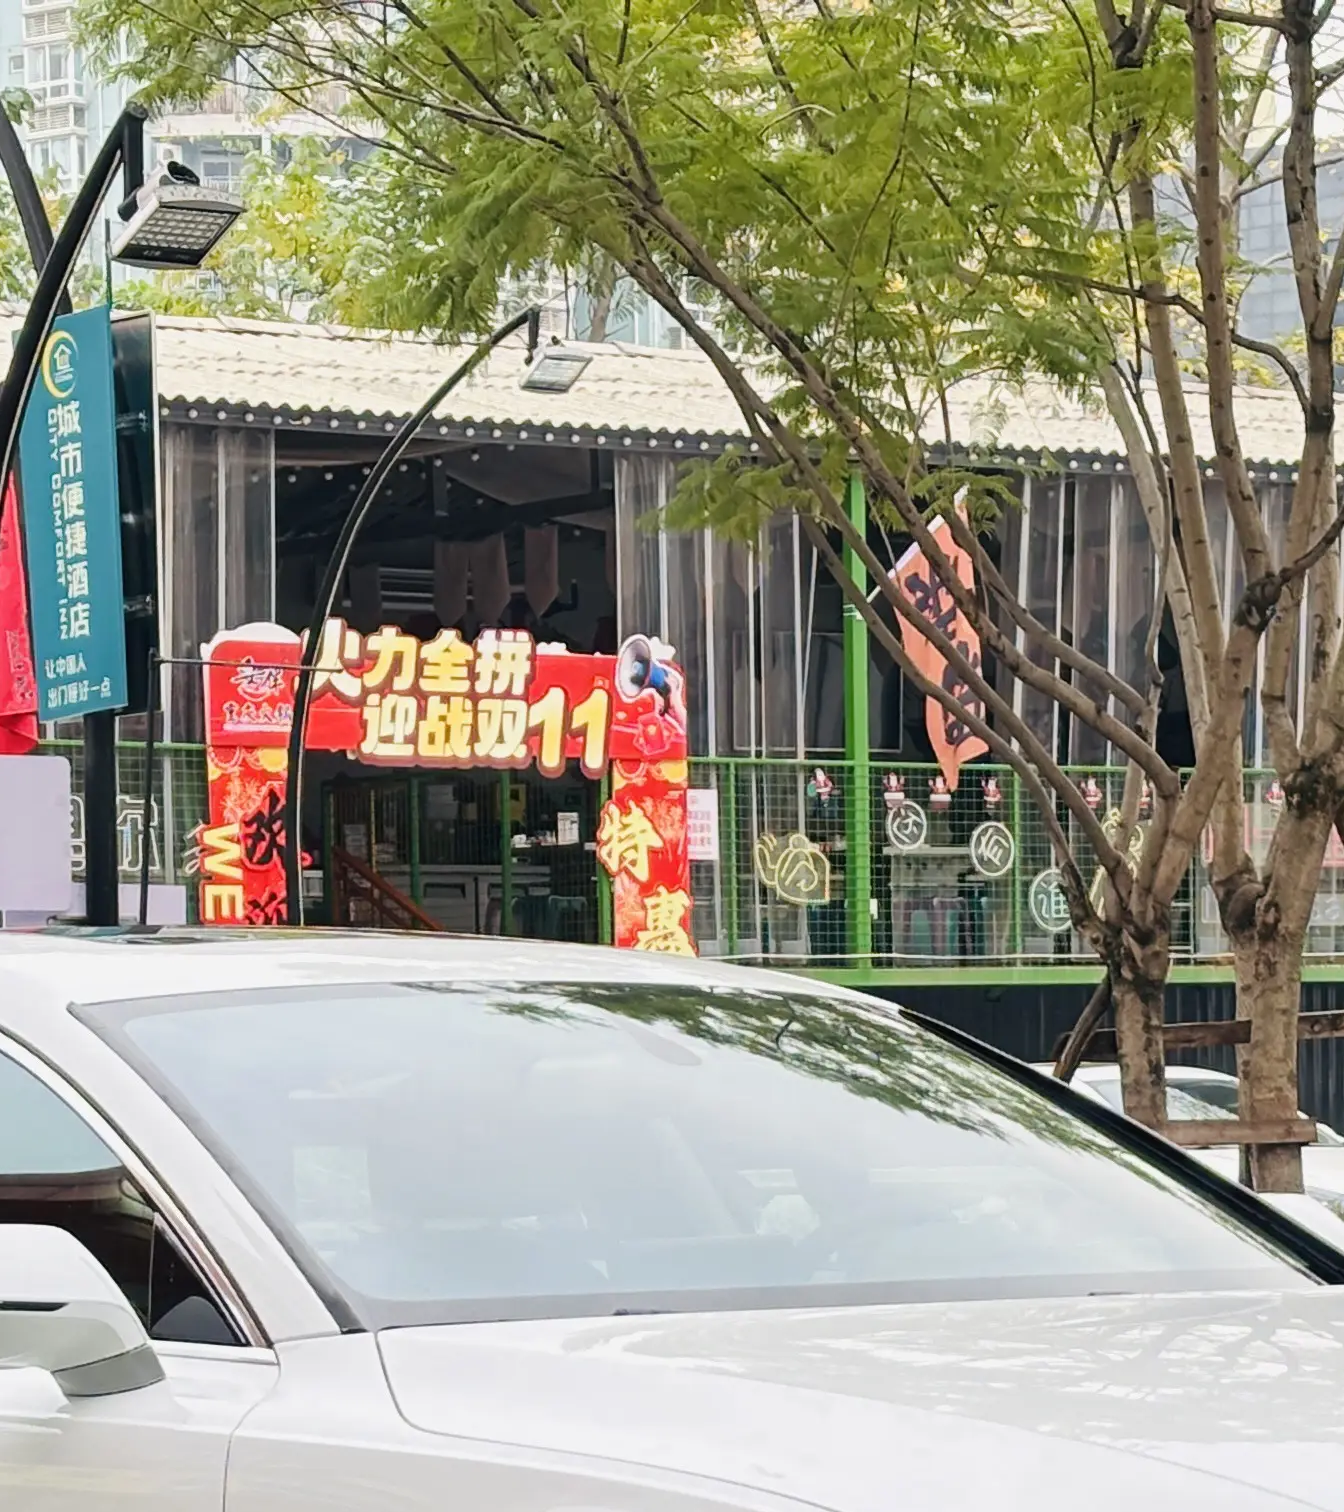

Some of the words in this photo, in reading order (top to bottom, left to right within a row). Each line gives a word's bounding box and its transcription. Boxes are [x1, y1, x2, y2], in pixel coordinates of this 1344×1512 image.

[57, 400, 90, 638] 城市便捷酒店
[361, 688, 609, 769] 迎战双11
